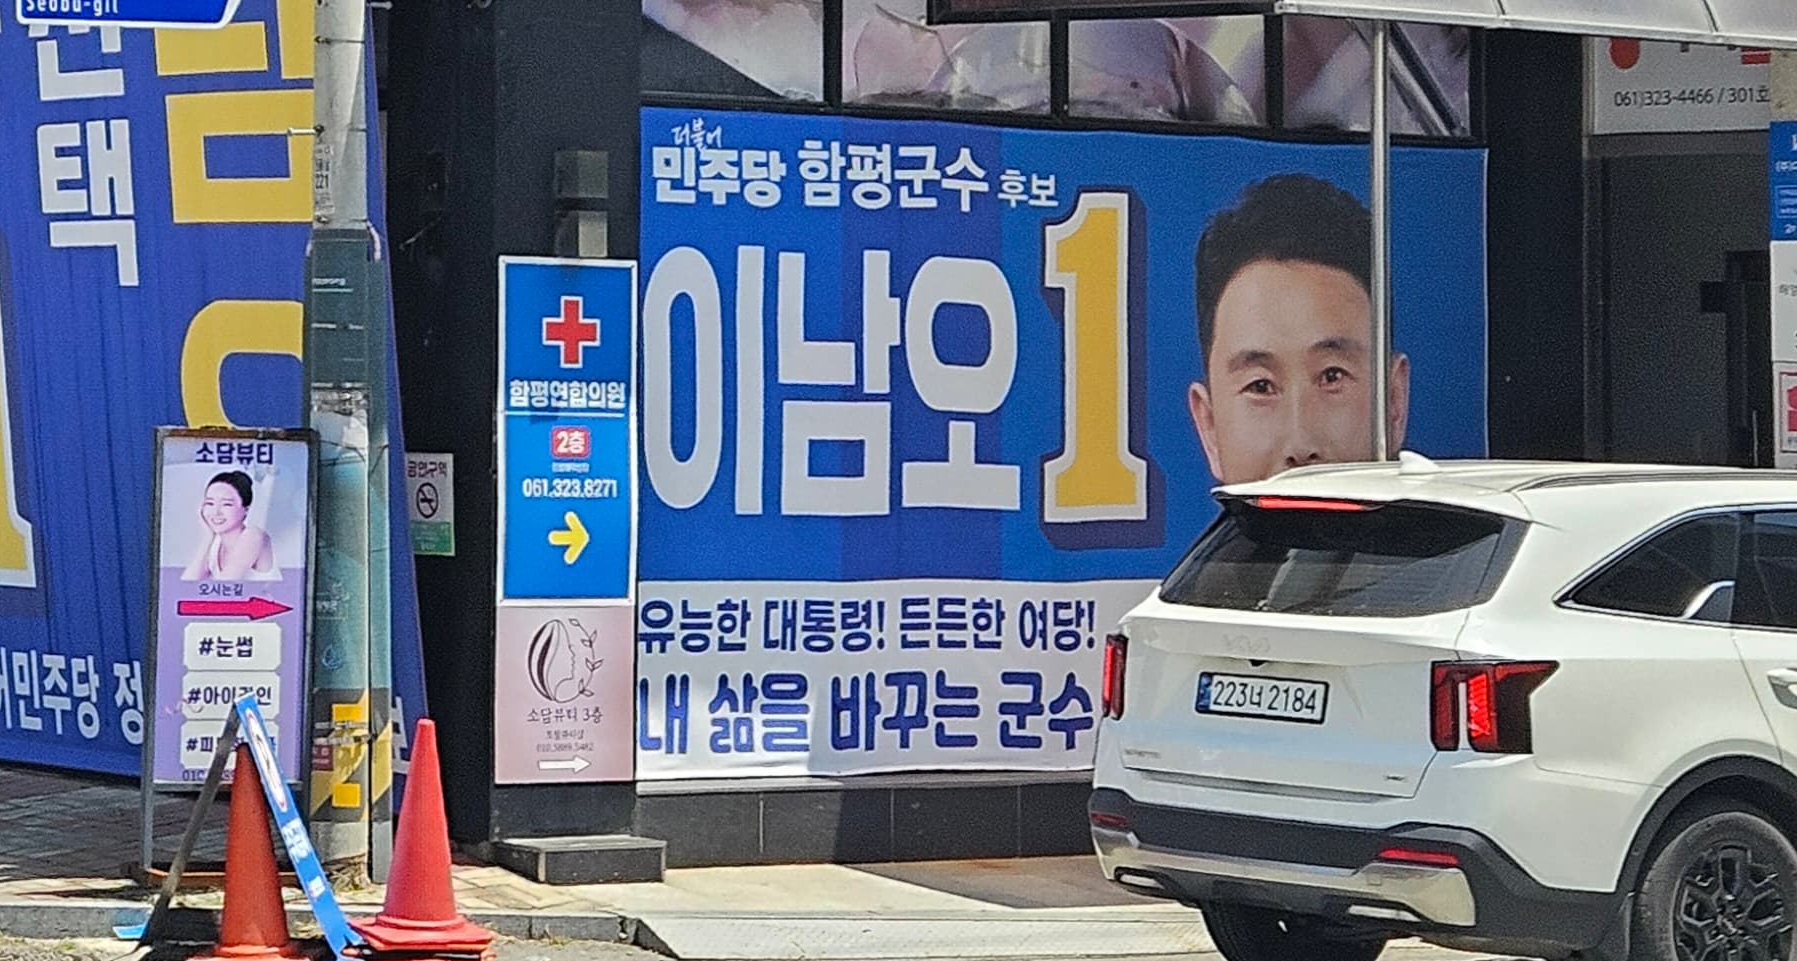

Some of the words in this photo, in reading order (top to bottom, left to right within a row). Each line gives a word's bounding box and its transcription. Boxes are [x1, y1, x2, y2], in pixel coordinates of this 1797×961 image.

[1728, 86, 1771, 104] 301호
[652, 144, 787, 208] 민주당
[798, 140, 989, 212] 함평군수
[998, 170, 1060, 209] 후보
[1044, 193, 1148, 522] 1
[509, 379, 626, 409] 함평연합의원
[643, 245, 1021, 516] 이남오
[194, 441, 275, 466] 소담뷰티
[556, 430, 586, 454] 2층
[522, 477, 618, 498] 061.323.8271
[199, 583, 244, 597] 오시는길
[637, 599, 752, 654] 유능한
[764, 597, 886, 654] 대통령!
[899, 597, 1005, 653] 든든한
[1018, 596, 1096, 652] 여당!
[199, 636, 254, 659] #눈썹
[1213, 680, 1263, 709] 223너
[1267, 685, 1317, 715] 2184
[526, 707, 579, 725] 소담뷰티
[582, 705, 604, 725] 3층
[640, 672, 691, 755] 내
[709, 671, 812, 754] 삶을
[832, 669, 979, 752] 바꾸는
[1000, 669, 1095, 750] 군수
